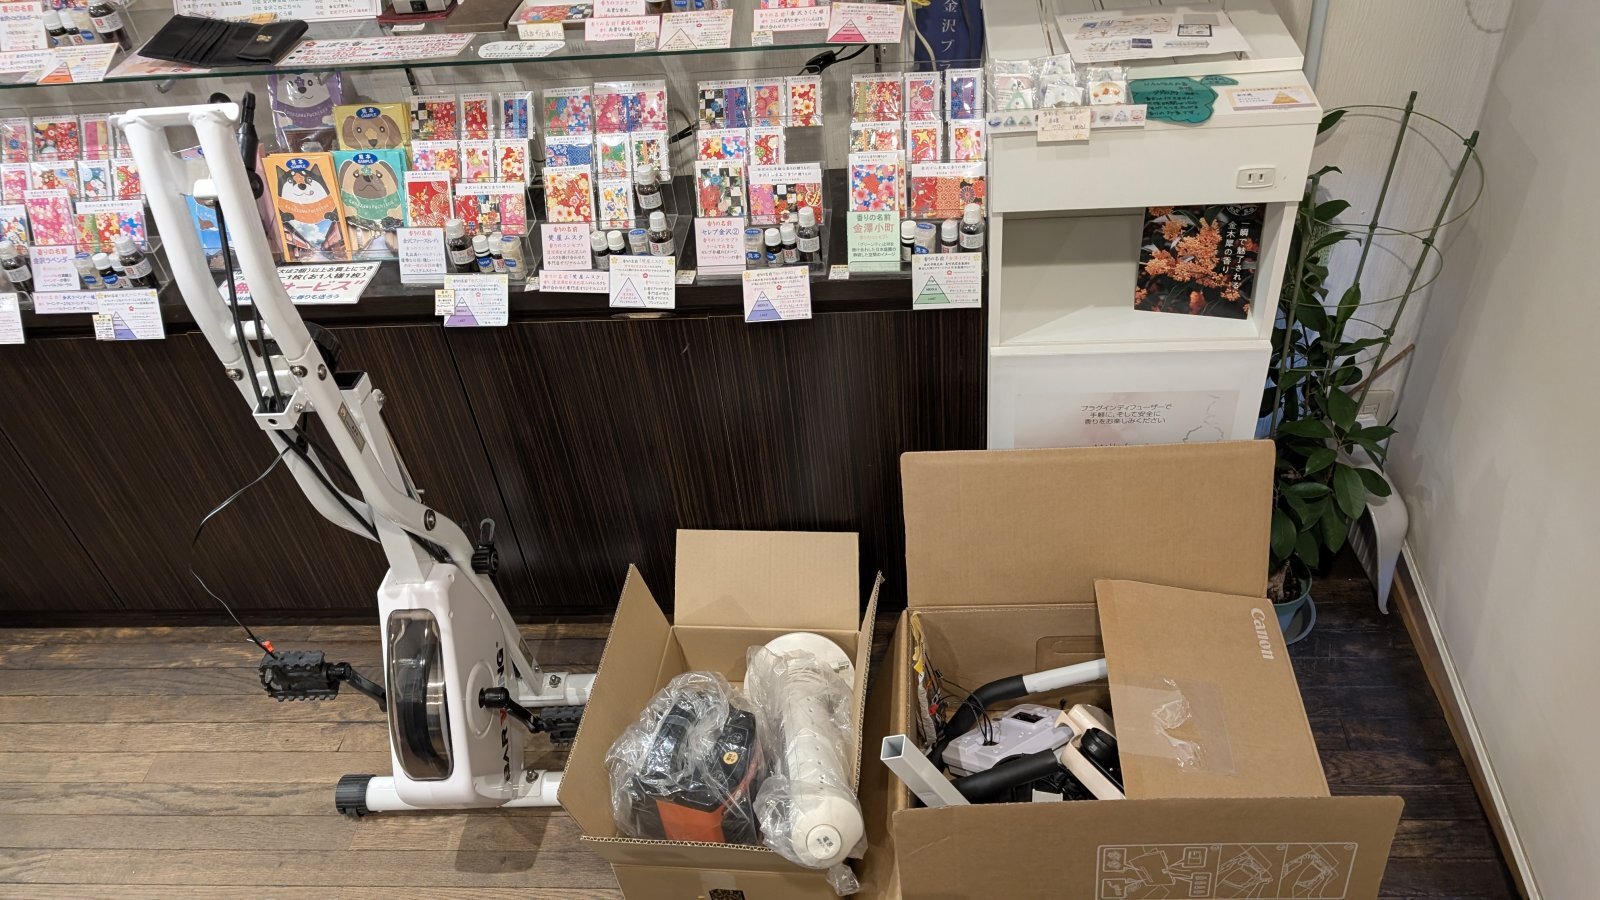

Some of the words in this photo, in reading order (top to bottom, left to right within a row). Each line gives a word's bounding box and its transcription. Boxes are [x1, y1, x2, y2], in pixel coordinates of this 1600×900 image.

[702, 227, 739, 236] セレブ金沢②
[853, 222, 894, 233] 金澤小町
[1222, 221, 1238, 274] 金木犀の香り
[1231, 221, 1250, 290] 一瞬で魅了される
[1080, 403, 1173, 412] プラグインディフューザーで
[1250, 608, 1275, 661] Canon
